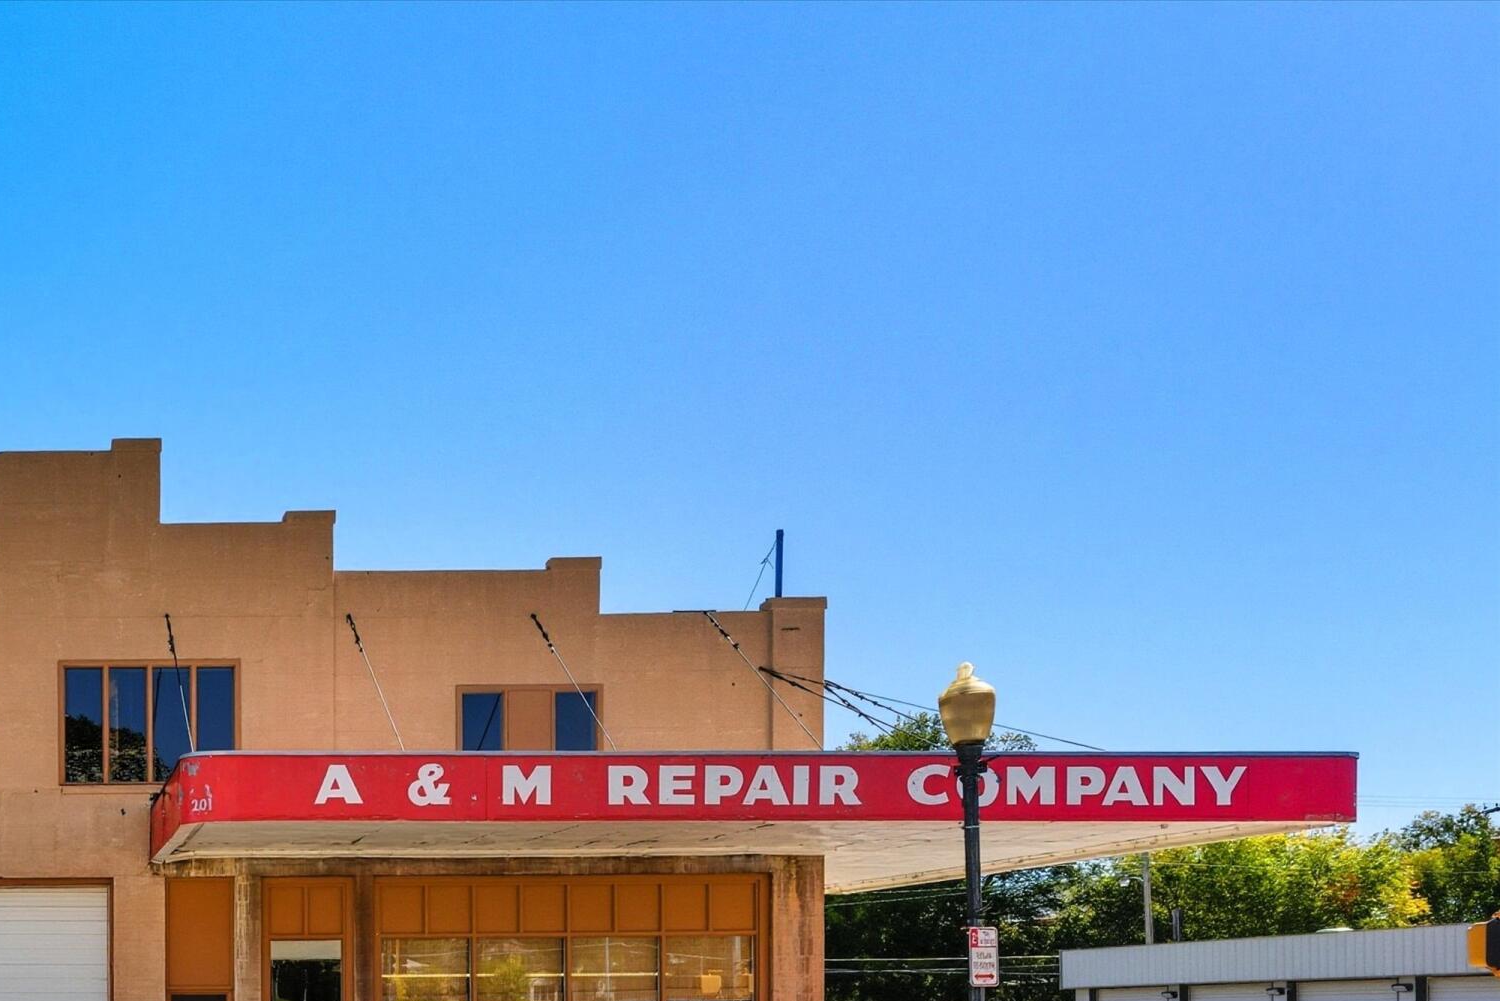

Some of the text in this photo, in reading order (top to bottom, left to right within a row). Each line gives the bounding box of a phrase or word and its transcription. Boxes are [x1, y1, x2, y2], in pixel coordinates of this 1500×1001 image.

[315, 764, 1247, 807] A & M REPAIR COMPANY
[191, 798, 212, 812] 201
